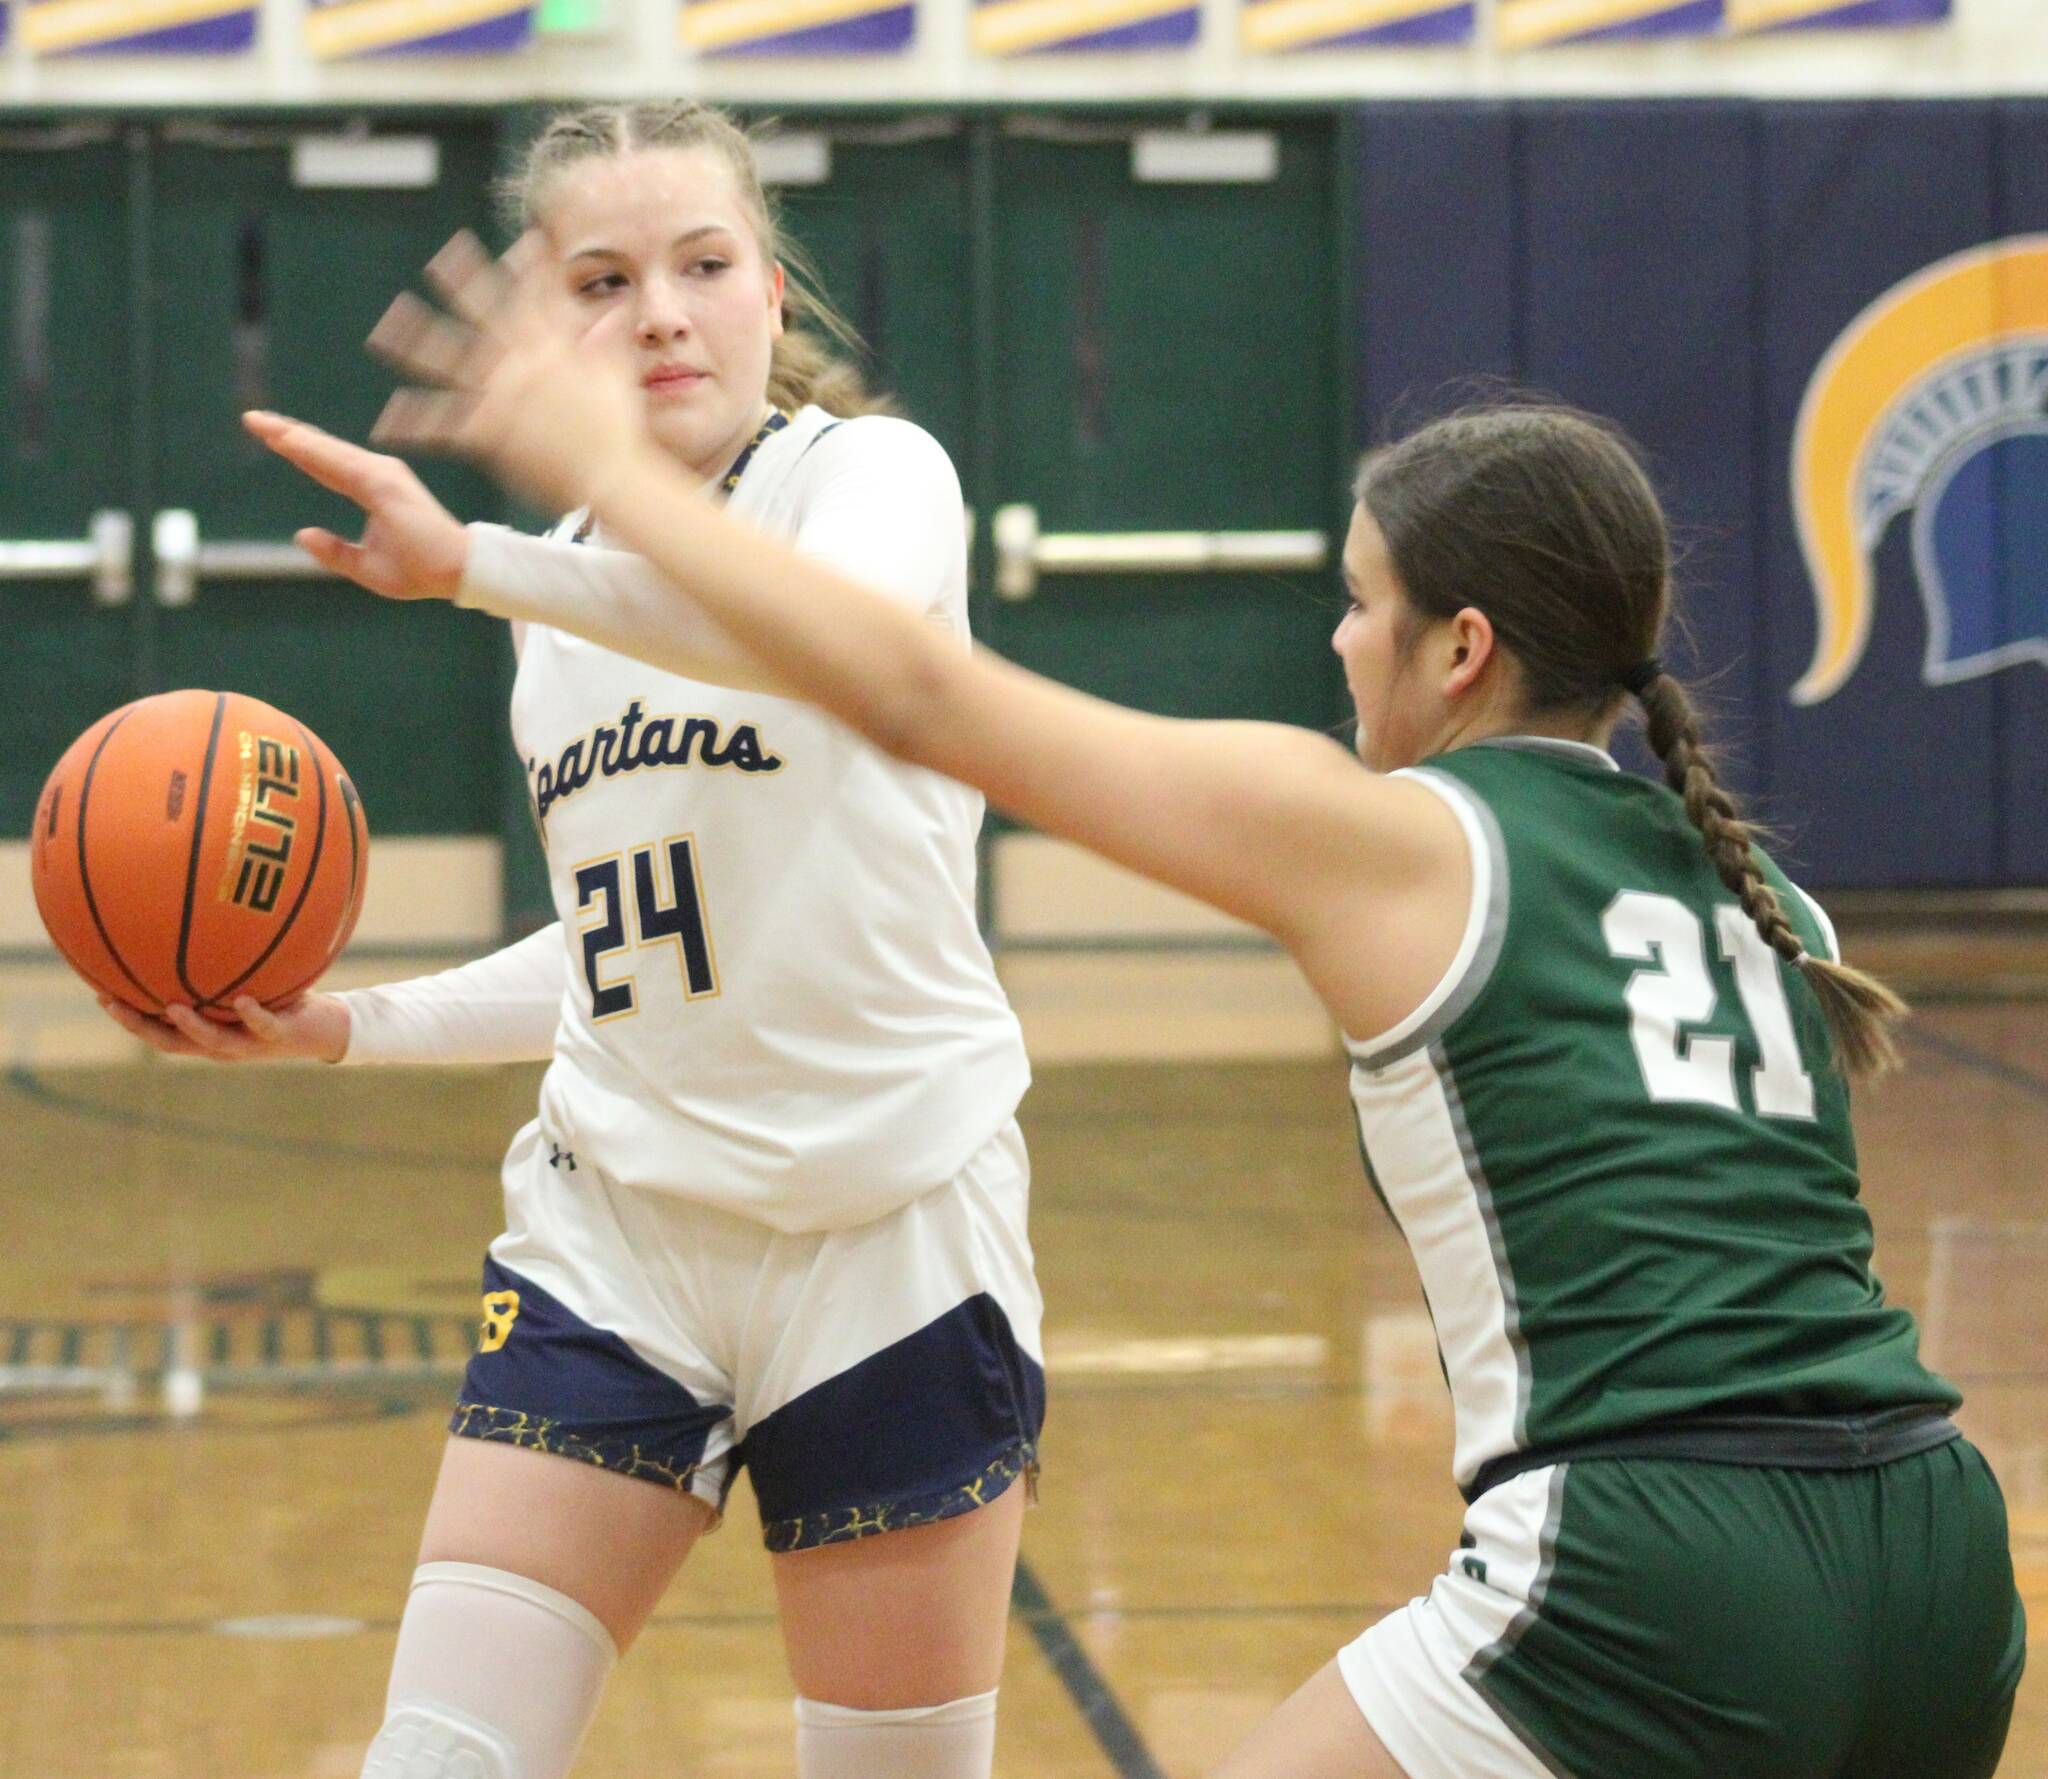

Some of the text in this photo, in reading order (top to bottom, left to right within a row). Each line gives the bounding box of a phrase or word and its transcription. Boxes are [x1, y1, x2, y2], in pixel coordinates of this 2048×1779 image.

[218, 731, 252, 902] CHMPION
[232, 736, 300, 915] ELITE
[529, 697, 786, 820] partans
[572, 832, 721, 1024] 24
[1599, 888, 1818, 1122] 21
